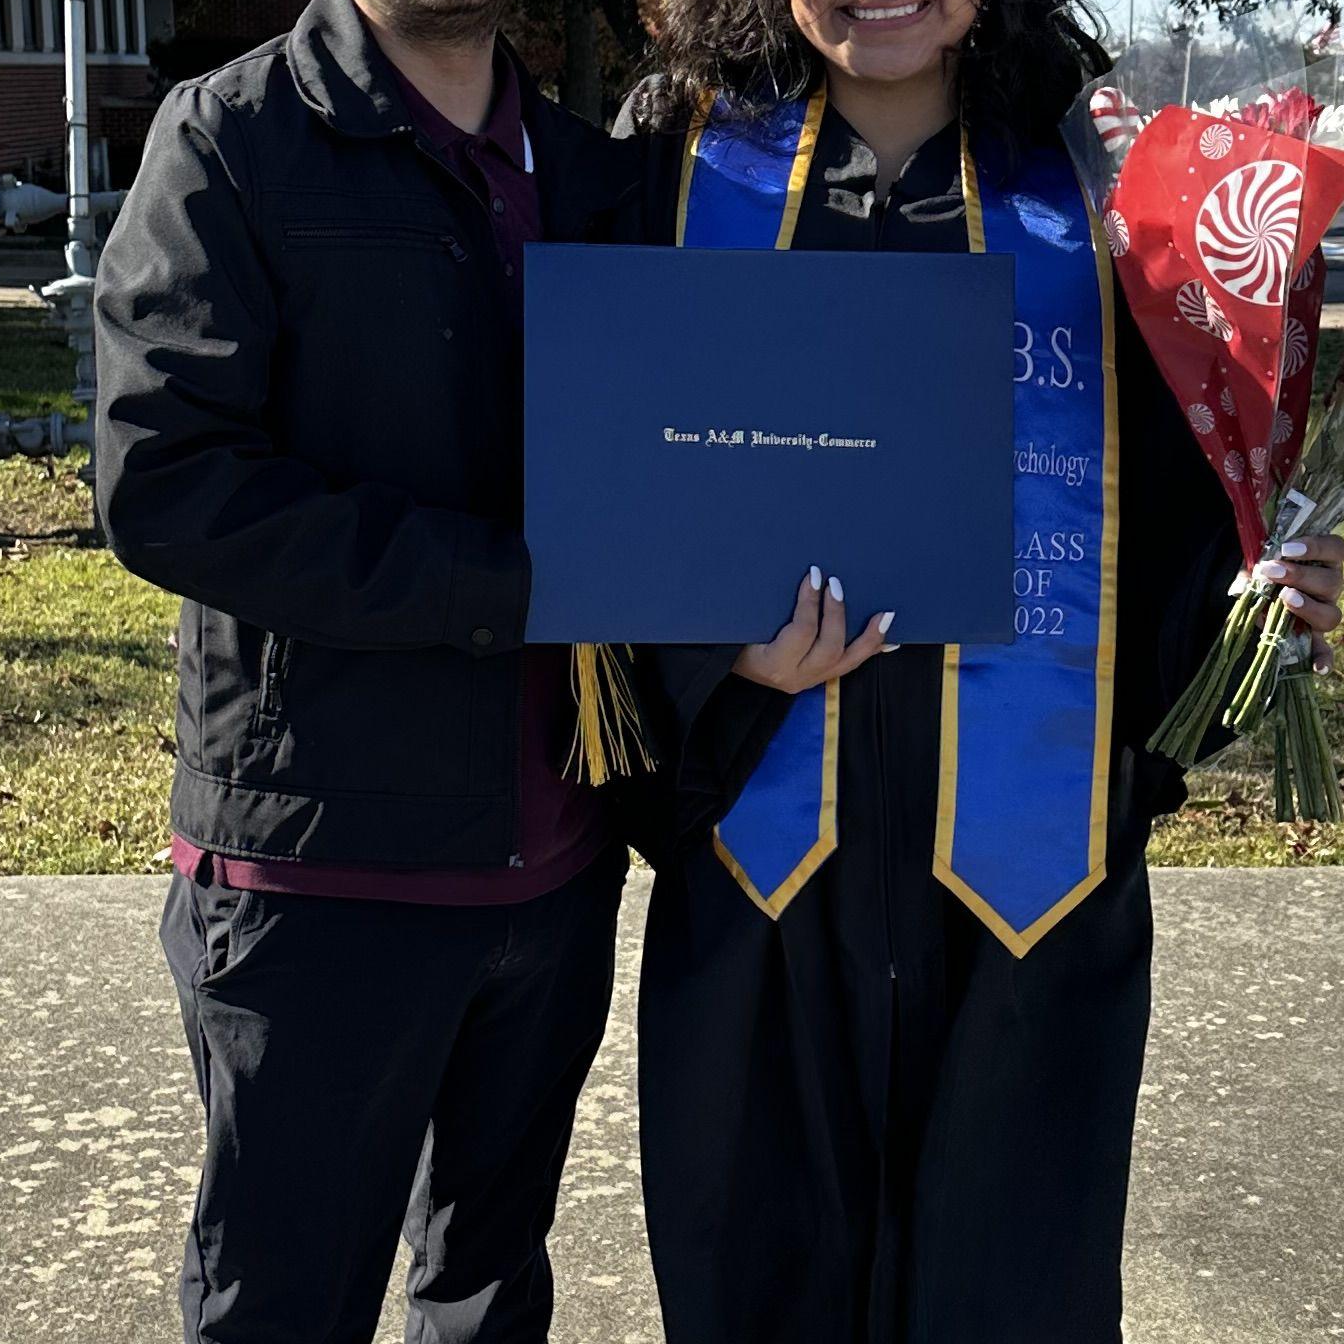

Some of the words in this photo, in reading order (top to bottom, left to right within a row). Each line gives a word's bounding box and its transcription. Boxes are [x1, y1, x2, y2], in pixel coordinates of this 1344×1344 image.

[1013, 321, 1085, 391] B.S.
[663, 427, 700, 443] Texas
[706, 429, 744, 448] A&M
[751, 430, 877, 450] University-Commerce
[1013, 441, 1090, 487] chology
[1013, 567, 1053, 598] OF
